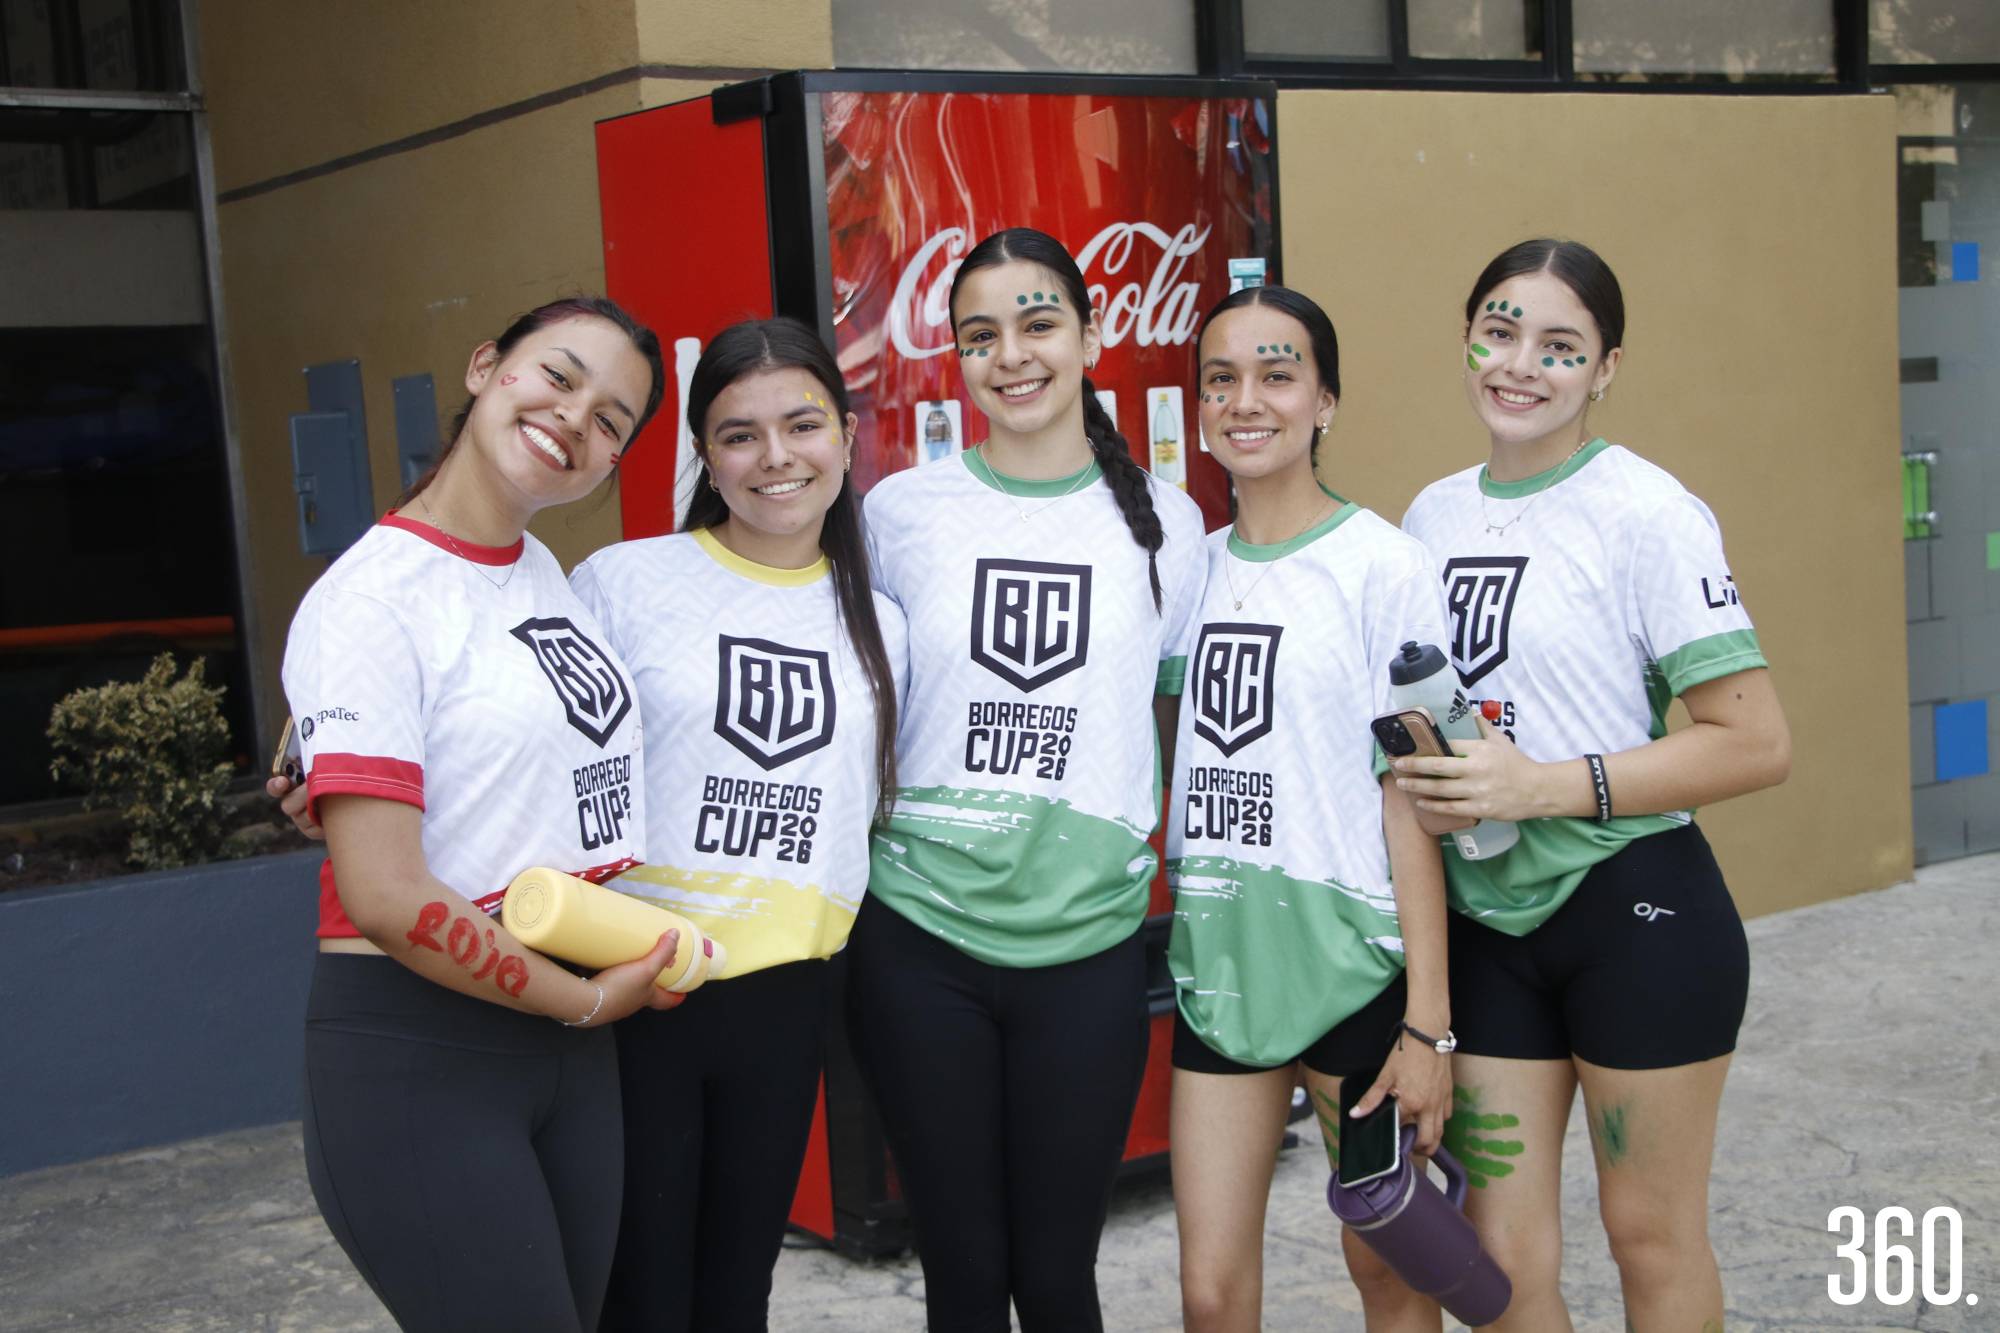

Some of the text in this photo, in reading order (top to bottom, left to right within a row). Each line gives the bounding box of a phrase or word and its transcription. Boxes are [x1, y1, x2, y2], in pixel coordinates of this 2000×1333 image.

[992, 577, 1071, 667] BC
[737, 653, 816, 745] BC
[1201, 641, 1262, 732] BC
[968, 701, 1078, 733] BORREGOS
[965, 728, 1072, 775] CUP 20
[1036, 756, 1067, 781] 26
[1591, 757, 1604, 783] LUZ
[573, 754, 631, 798] BORREGO
[702, 775, 822, 814] BORREGOS
[577, 788, 624, 851] CUP
[694, 804, 817, 858] CUP 20
[1185, 794, 1273, 842] CUP 20
[1241, 823, 1272, 847] 26
[776, 838, 813, 865] 26
